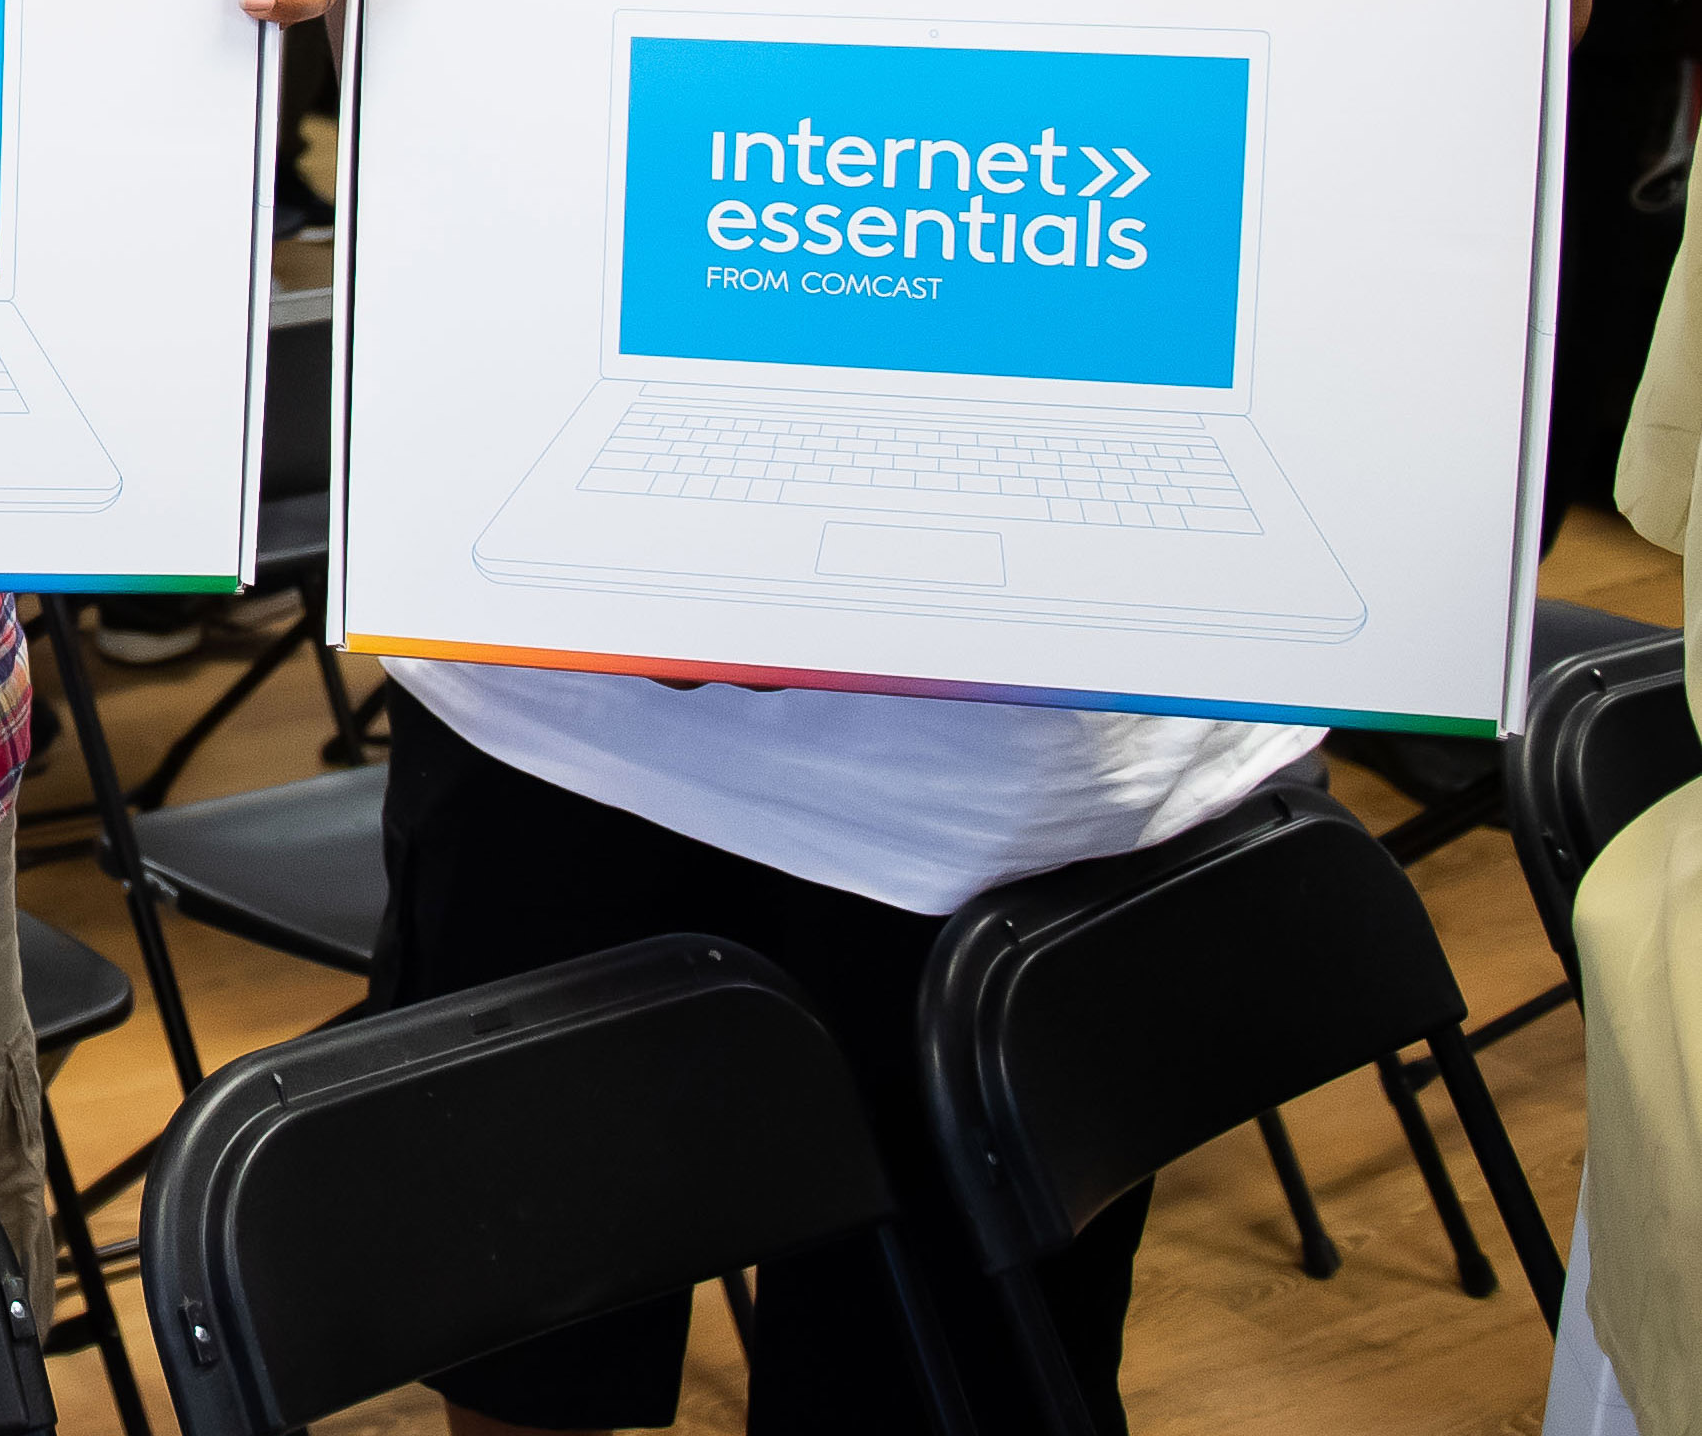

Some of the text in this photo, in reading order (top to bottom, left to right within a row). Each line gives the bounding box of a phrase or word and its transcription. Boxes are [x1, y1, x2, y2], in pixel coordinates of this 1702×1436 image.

[711, 117, 1068, 196] internet
[706, 194, 1148, 270] essentials
[706, 266, 943, 301] FROM COMCAST
